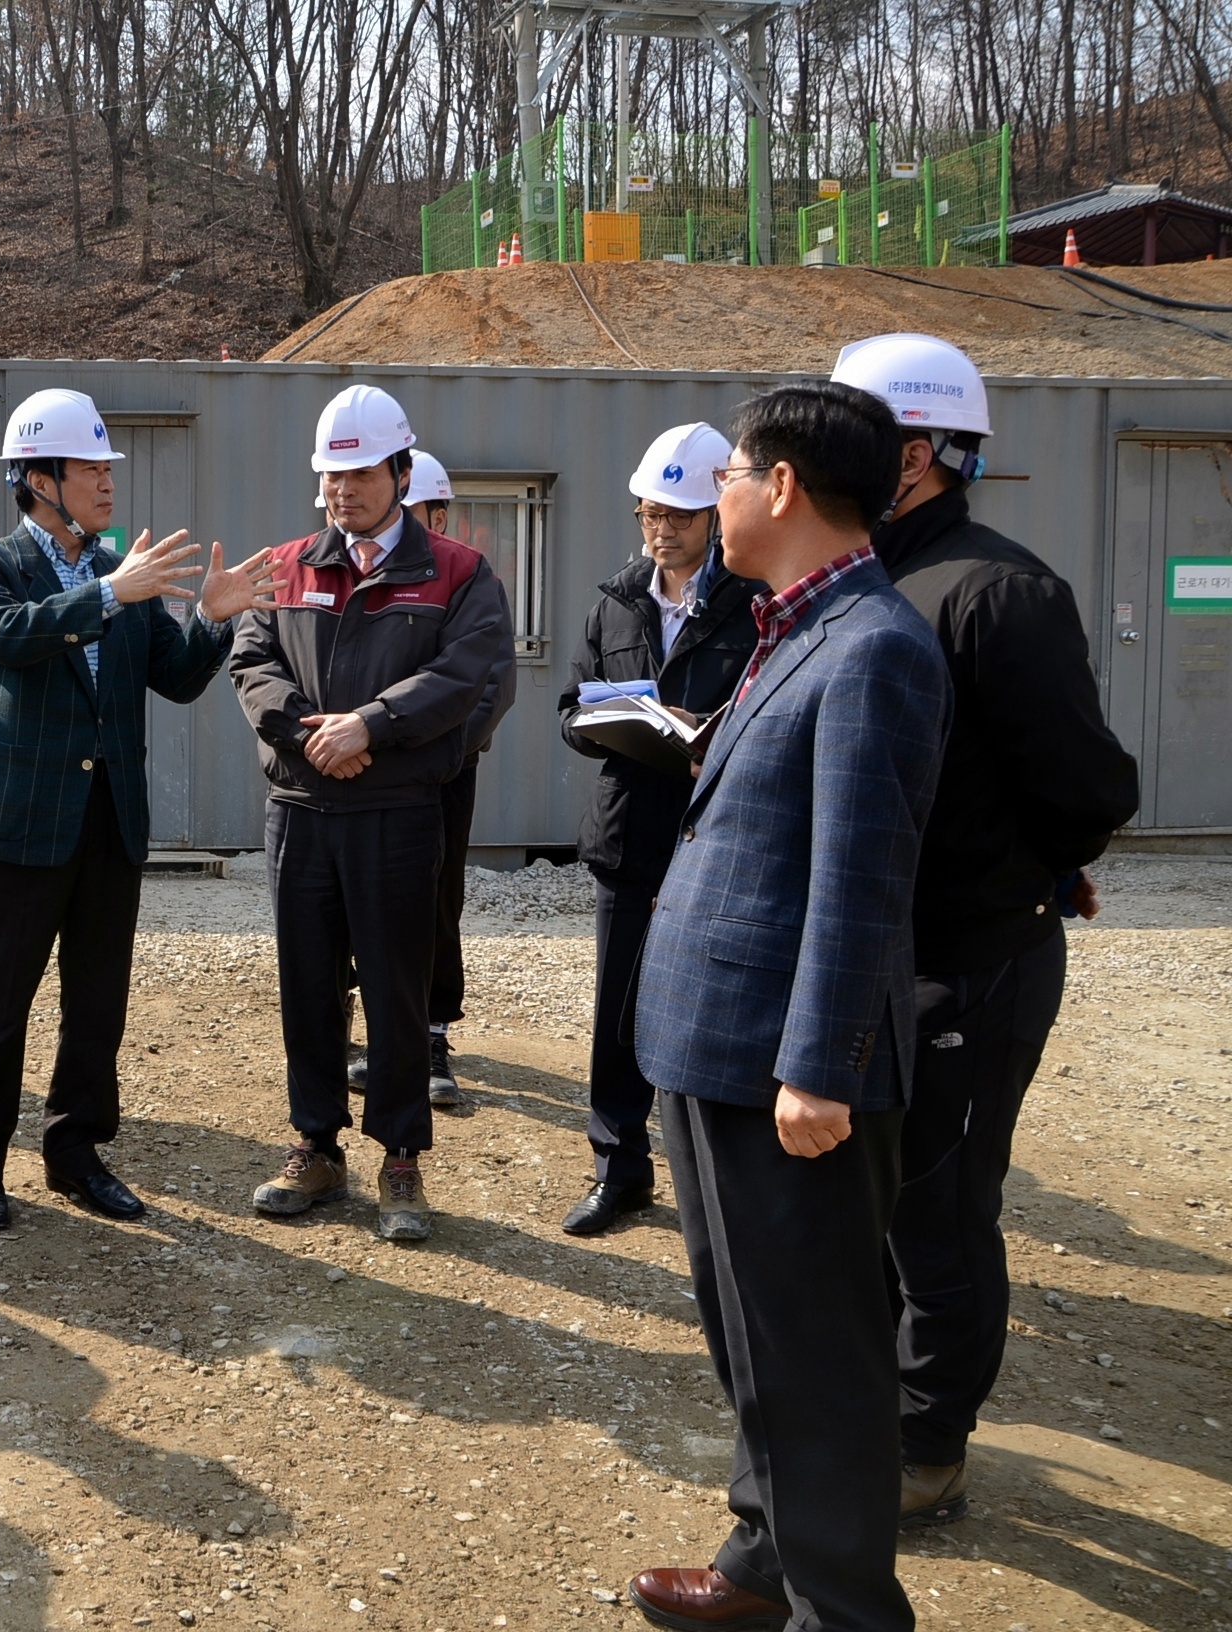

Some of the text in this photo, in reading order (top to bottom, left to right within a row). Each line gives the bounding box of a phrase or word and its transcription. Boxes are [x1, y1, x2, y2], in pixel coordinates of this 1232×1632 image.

[888, 381, 964, 399] (주)경동엔지니어링
[18, 422, 44, 437] VIP
[331, 440, 357, 448] TAEYOUNG
[1177, 577, 1207, 589] 근로자
